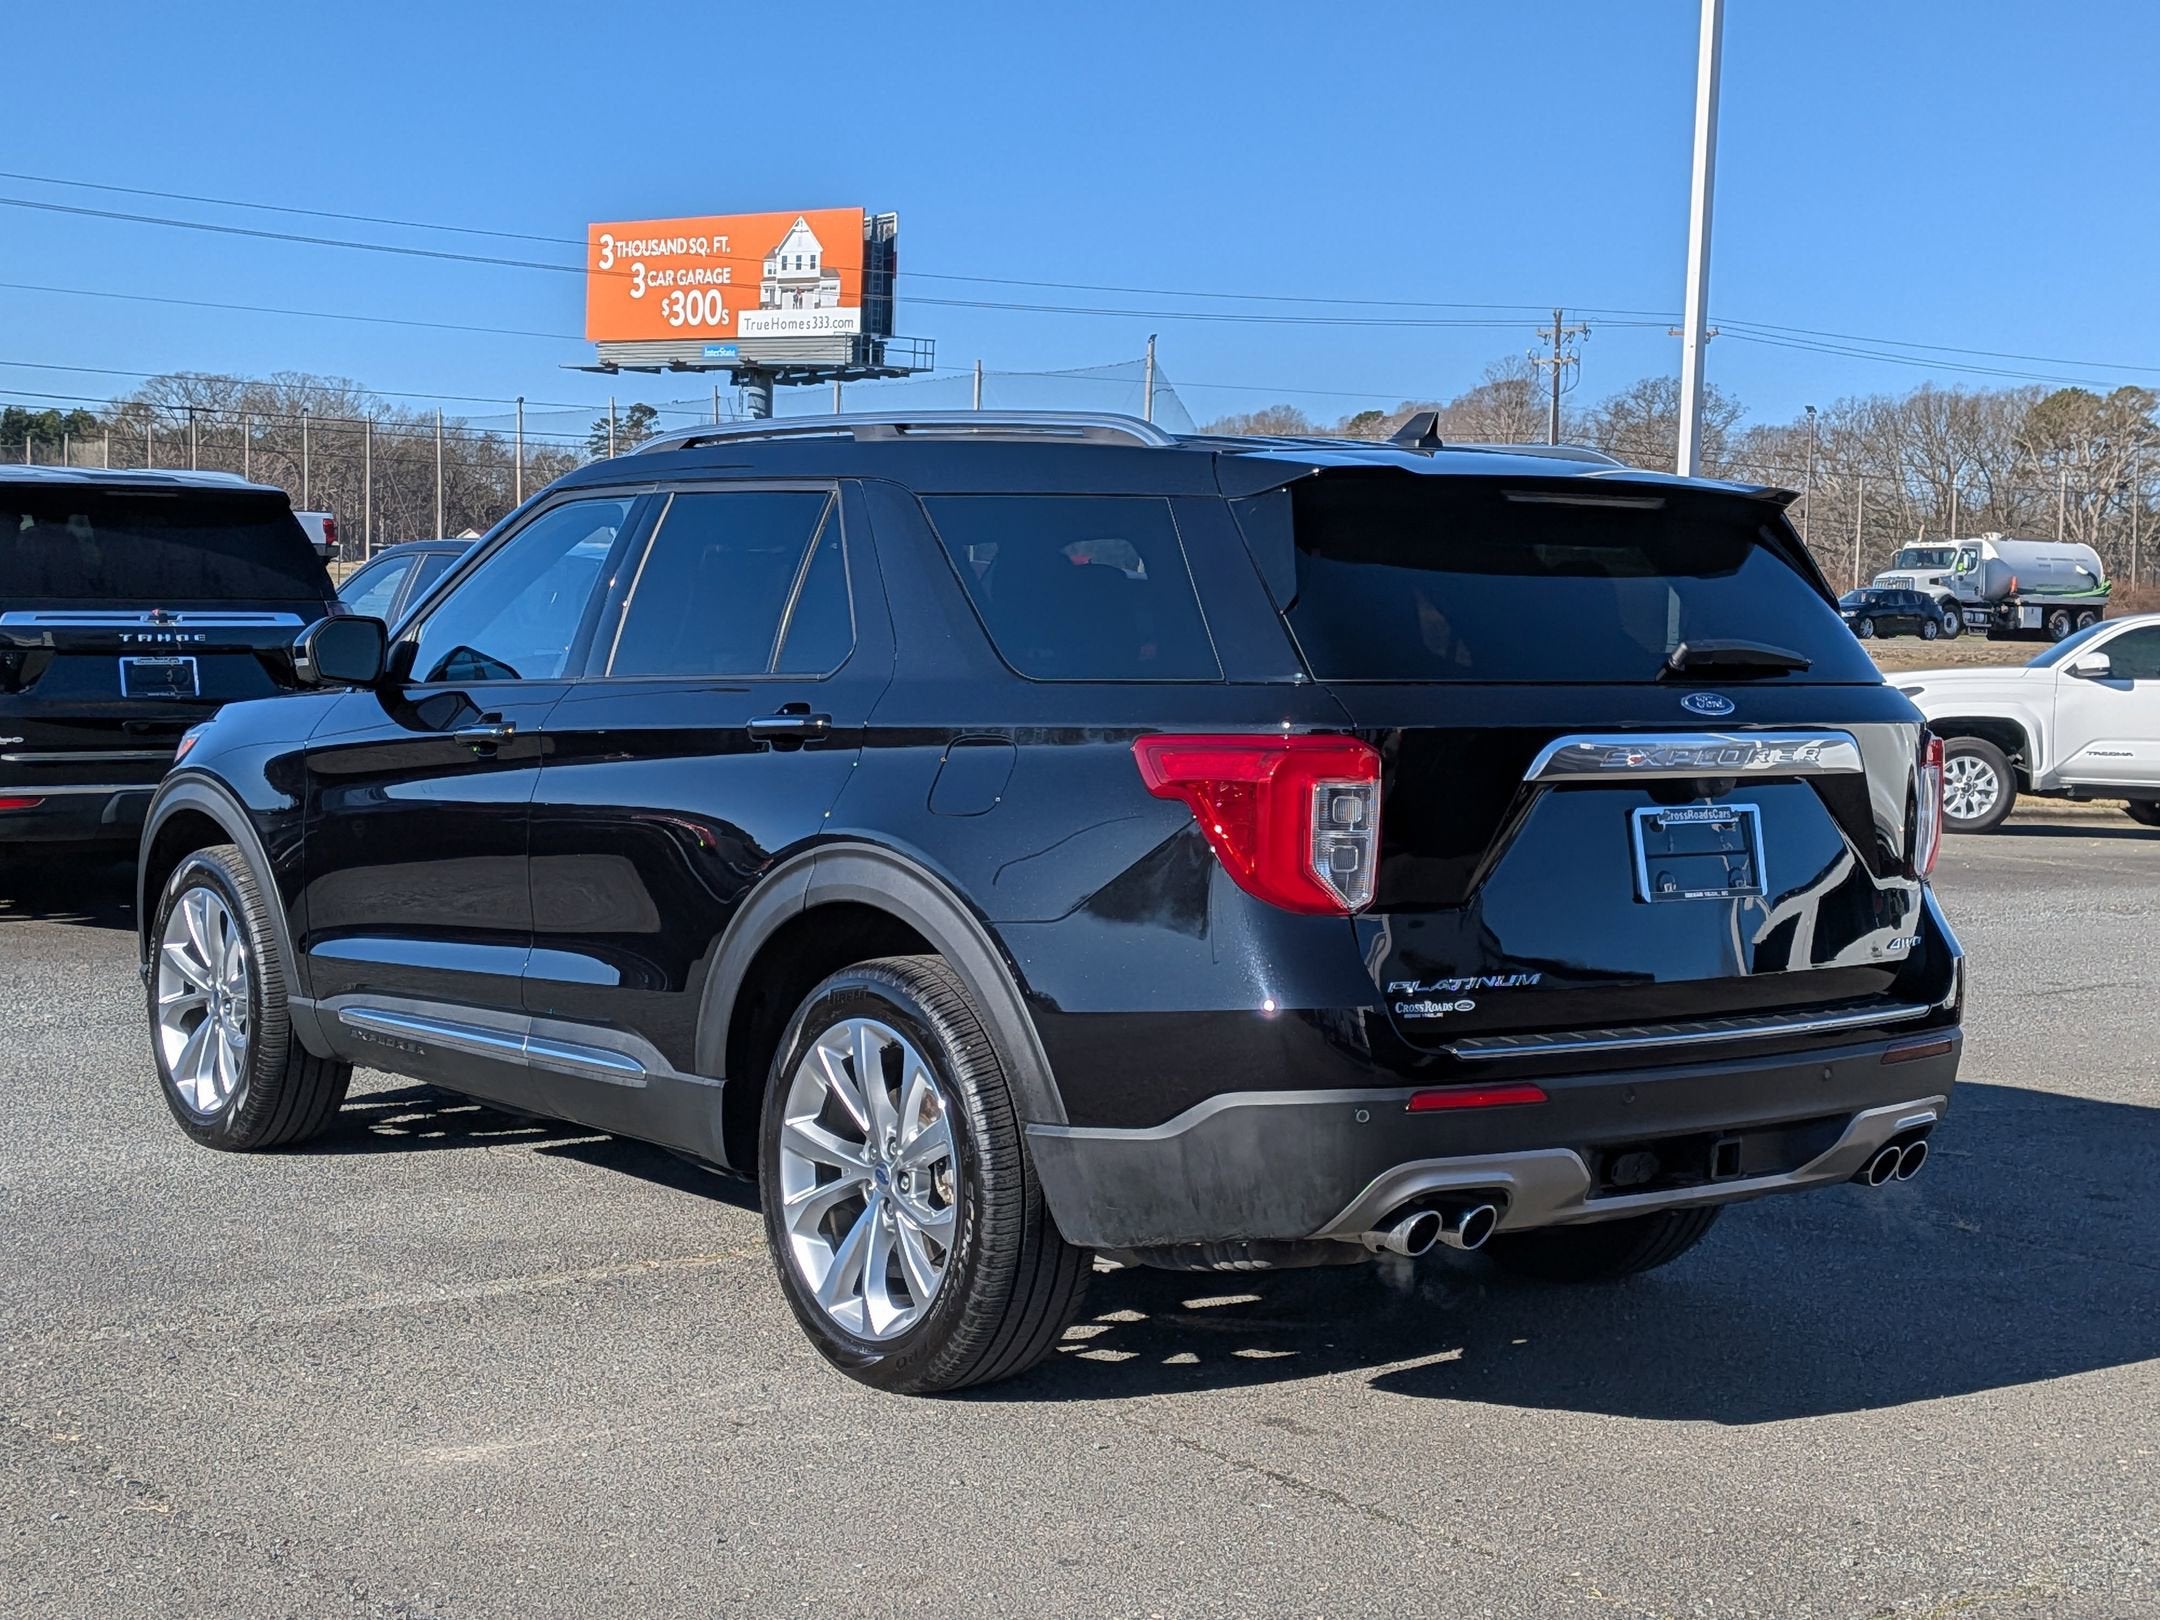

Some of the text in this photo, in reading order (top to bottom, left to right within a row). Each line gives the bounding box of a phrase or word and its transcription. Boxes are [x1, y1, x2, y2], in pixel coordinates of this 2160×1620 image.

[598, 233, 731, 270] 3 THOUSAND SQ. FT.
[629, 262, 732, 299] 3 CAR GARAGE
[743, 315, 854, 332] TrueHomes333.com
[1695, 695, 1726, 709] Ford
[1600, 747, 1822, 770] EXPLORER
[1387, 972, 1543, 993] PLATINUM
